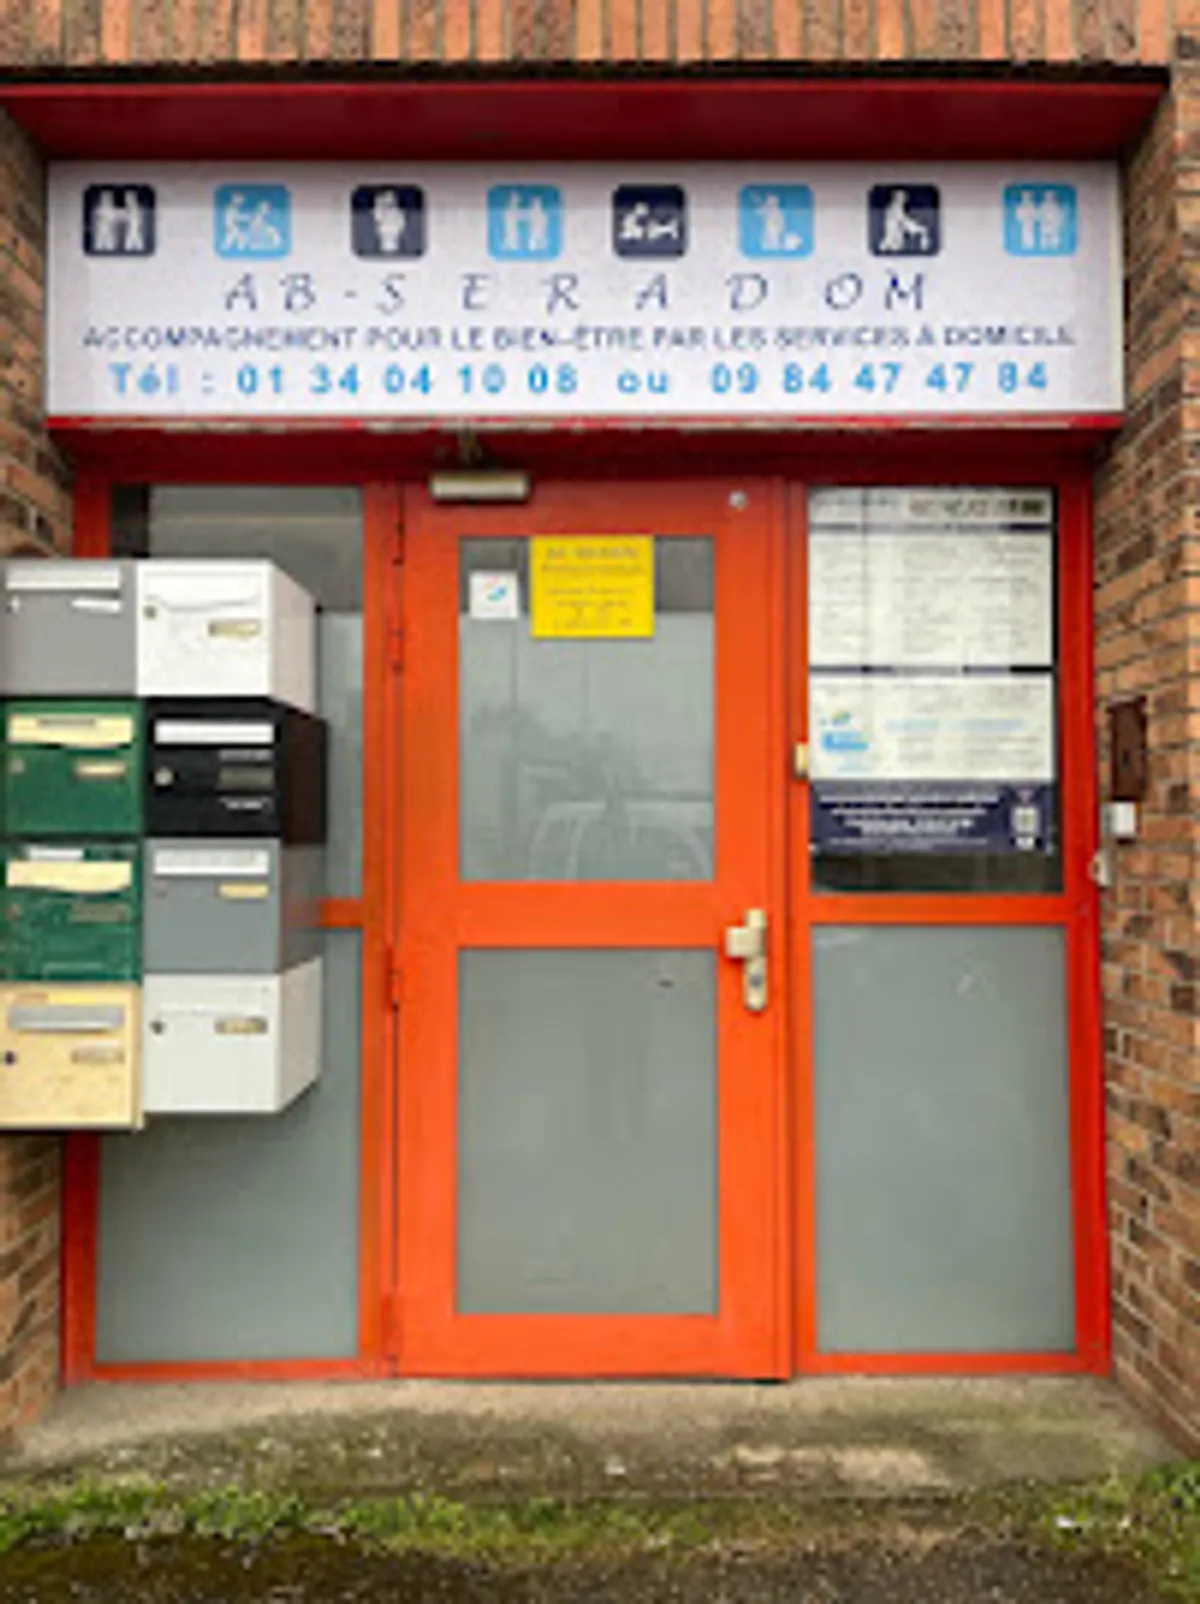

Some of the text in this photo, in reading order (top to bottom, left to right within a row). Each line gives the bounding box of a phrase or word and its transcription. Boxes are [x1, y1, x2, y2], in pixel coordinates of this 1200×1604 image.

[83, 325, 358, 350] ACCOMPAGNEMENT
[366, 325, 442, 350] POUR
[451, 325, 482, 350] LE
[652, 325, 708, 350] PAR
[712, 325, 768, 350] LES
[773, 325, 910, 350] SERVICES
[944, 325, 1076, 347] DOMICILE
[107, 361, 180, 395] Tél
[236, 361, 282, 395] 01
[309, 361, 359, 395] 34
[383, 361, 432, 395] 04
[458, 361, 507, 395] 10
[527, 361, 578, 395] 08
[616, 367, 669, 395] ou
[710, 361, 760, 395] 09
[781, 361, 832, 395] 84
[853, 361, 902, 395] 47
[924, 361, 975, 395] 47
[997, 361, 1049, 395] 84
